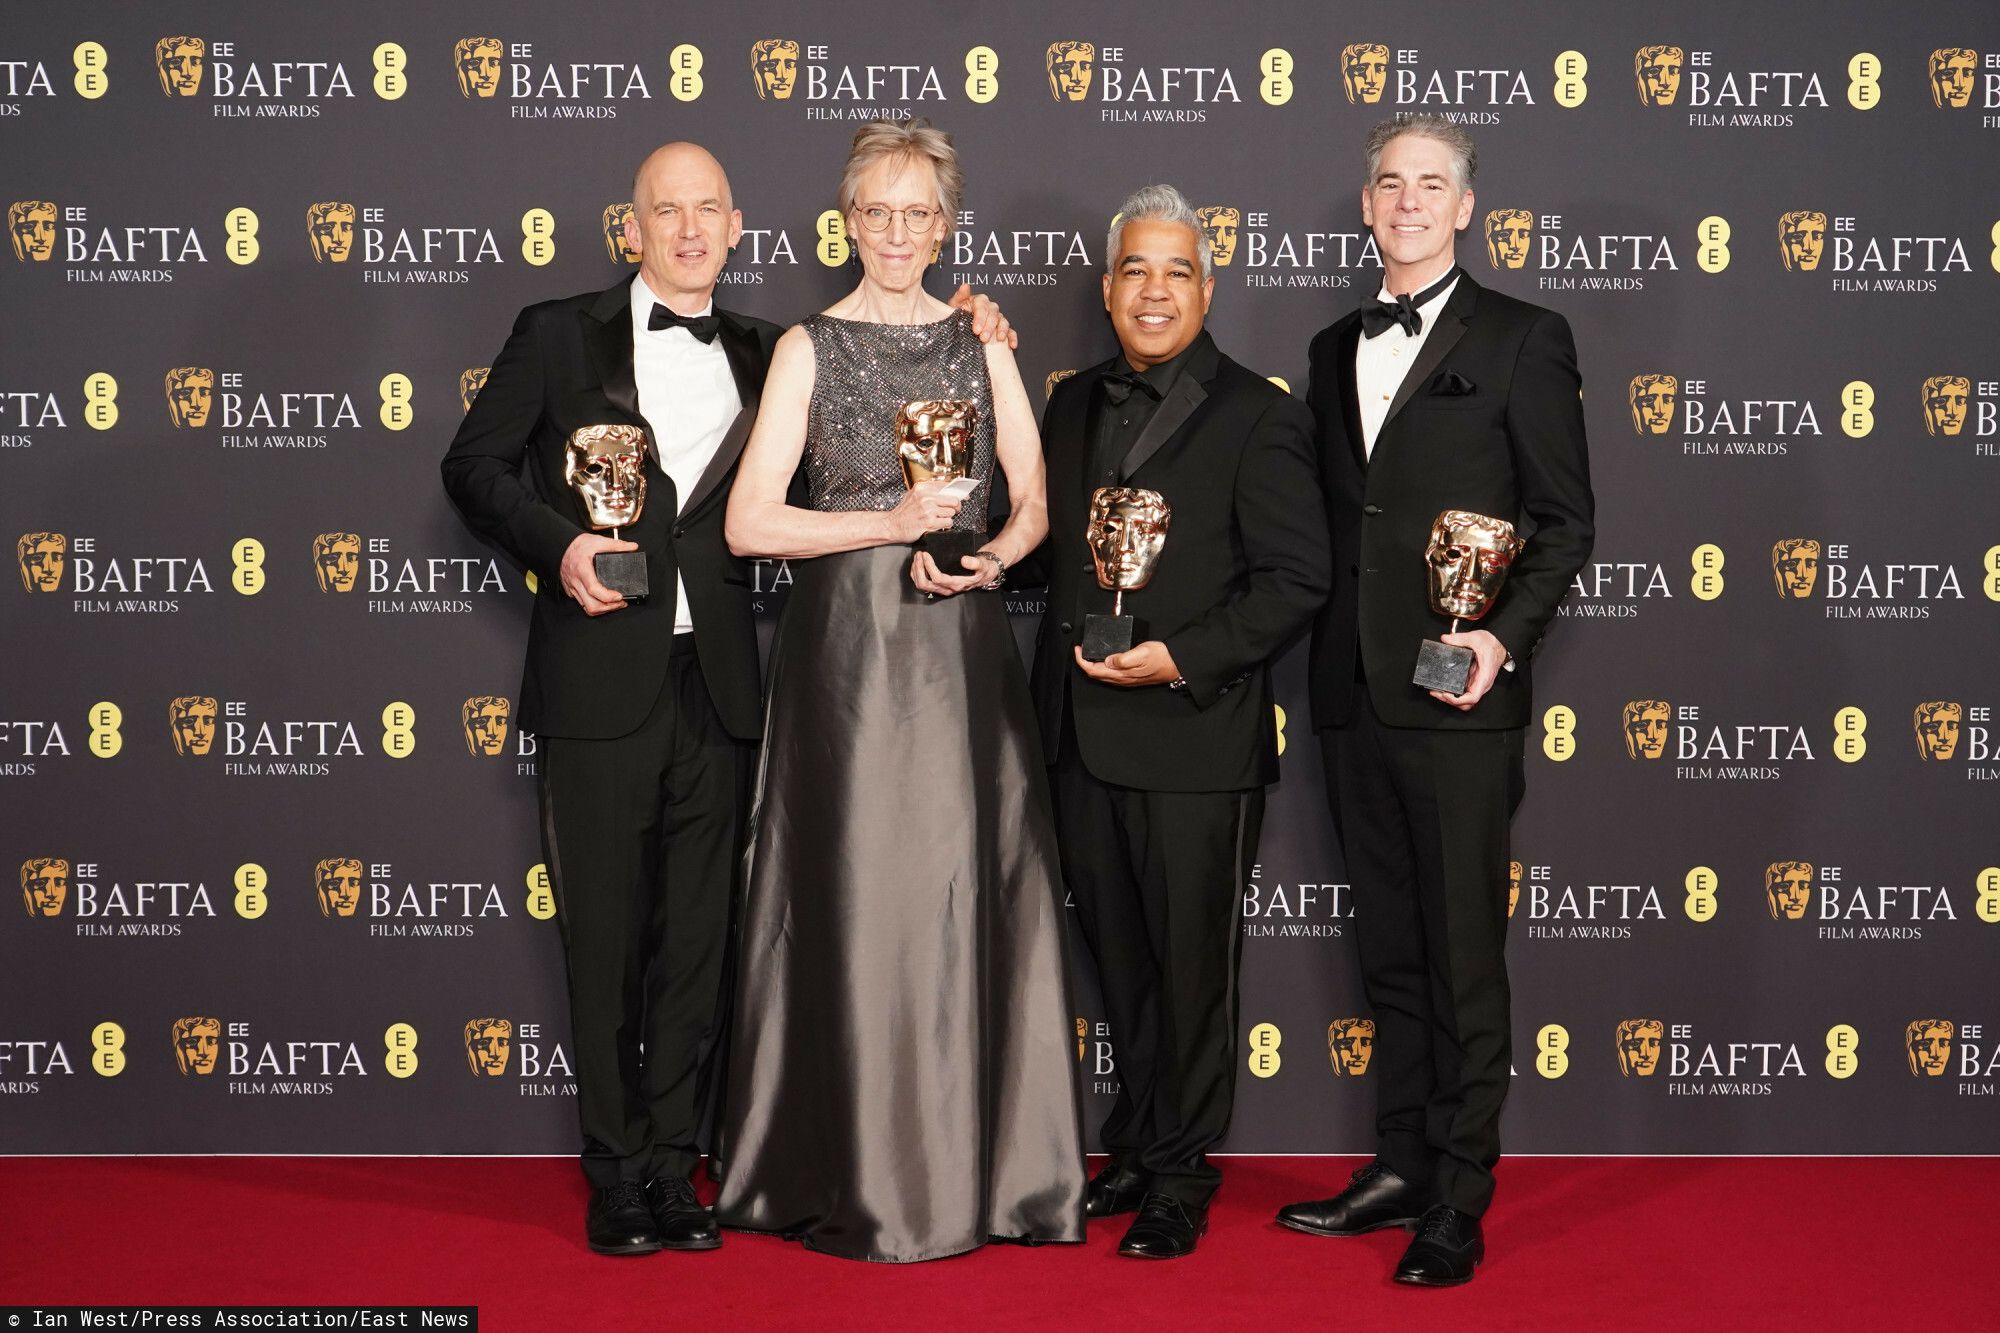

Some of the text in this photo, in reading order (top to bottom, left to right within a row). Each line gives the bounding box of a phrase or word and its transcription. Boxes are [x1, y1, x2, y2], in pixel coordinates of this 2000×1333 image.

[213, 43, 234, 56] EE
[512, 44, 532, 57] EE
[808, 46, 828, 59] EE
[1103, 48, 1123, 61] EE
[1398, 50, 1418, 63] EE
[1692, 52, 1712, 66] EE
[212, 62, 355, 97] BAFTA
[511, 64, 652, 98] BAFTA
[806, 65, 947, 100] BAFTA
[1102, 68, 1241, 102] BAFTA
[1396, 70, 1535, 104] BAFTA
[1689, 72, 1829, 107] BAFTA
[214, 105, 320, 117] FILM AWARDS
[512, 106, 616, 118] FILM AWARDS
[807, 108, 913, 120] FILM AWARDS
[1102, 110, 1206, 122] FILM AWARDS
[1690, 114, 1793, 126] FILM AWARDS
[66, 207, 87, 221] EE
[364, 208, 384, 222] EE
[1248, 213, 1268, 227] EE
[1541, 215, 1561, 229] EE
[1835, 217, 1855, 231] EE
[65, 227, 208, 262] BAFTA
[363, 228, 504, 262] BAFTA
[953, 231, 1092, 265] BAFTA
[1246, 233, 1385, 267] BAFTA
[1540, 235, 1678, 270] BAFTA
[1833, 237, 1972, 271] BAFTA
[67, 270, 172, 282] FILM AWARDS
[365, 271, 468, 283] FILM AWARDS
[953, 273, 1056, 285] FILM AWARDS
[1247, 275, 1350, 287] FILM AWARDS
[1540, 277, 1643, 290] FILM AWARDS
[1833, 279, 1936, 291] FILM AWARDS
[222, 374, 242, 387] EE
[1686, 381, 1705, 394] EE
[1978, 382, 1998, 396] EE
[221, 393, 362, 427] BAFTA
[1684, 401, 1822, 435] BAFTA
[1, 435, 31, 447] RDS
[223, 436, 326, 448] FILM AWARDS
[1684, 442, 1786, 454] FILM AWARDS
[1977, 444, 2000, 456] FIL
[74, 539, 95, 552] EE
[369, 539, 389, 552] EE
[1828, 545, 1848, 558] EE
[74, 558, 214, 592] BAFTA
[368, 558, 507, 592] BAFTA
[1566, 564, 1672, 598] AFTA
[1826, 565, 1965, 598] BAFTA
[75, 601, 178, 612] FILM AWARDS
[369, 601, 472, 612] FILM AWARDS
[1575, 605, 1637, 617] AWARDS
[1827, 606, 1929, 618] FILM AWARDS
[226, 702, 246, 715] EE
[1679, 707, 1699, 720] EE
[1970, 708, 1990, 721] EE
[225, 722, 364, 755] BAFTA
[1677, 726, 1815, 759] BAFTA
[226, 764, 329, 775] FILM AWARDS
[518, 764, 537, 775] FIL
[1678, 767, 1779, 779] FILM AWARDS
[77, 864, 97, 877] EE
[371, 864, 391, 877] EE
[1531, 867, 1550, 880] EE
[1821, 867, 1841, 880] EE
[76, 883, 216, 916] BAFTA
[370, 884, 508, 917] BAFTA
[1243, 884, 1354, 917] BAFT
[1529, 886, 1666, 919] BAFTA
[1819, 886, 1957, 920] BAFTA
[77, 924, 181, 935] FILM AWARDS
[371, 925, 473, 936] FILM AWARDS
[1280, 925, 1341, 936] AWARDS
[1529, 927, 1630, 938] FILM AWARDS
[1820, 927, 1921, 939] FILM AWARDS
[229, 1023, 249, 1036] EE
[520, 1024, 540, 1037] EE
[1672, 1025, 1691, 1038] EE
[1962, 1025, 1982, 1038] EE
[228, 1042, 367, 1075] BAFTA
[1670, 1044, 1806, 1076] BAFTA
[0, 1082, 38, 1094] ARDS
[230, 1083, 332, 1094] FILM AWARDS
[521, 1084, 555, 1095] FILM
[1670, 1083, 1771, 1095] FILM AWARDS
[1960, 1084, 1993, 1095] FILM
